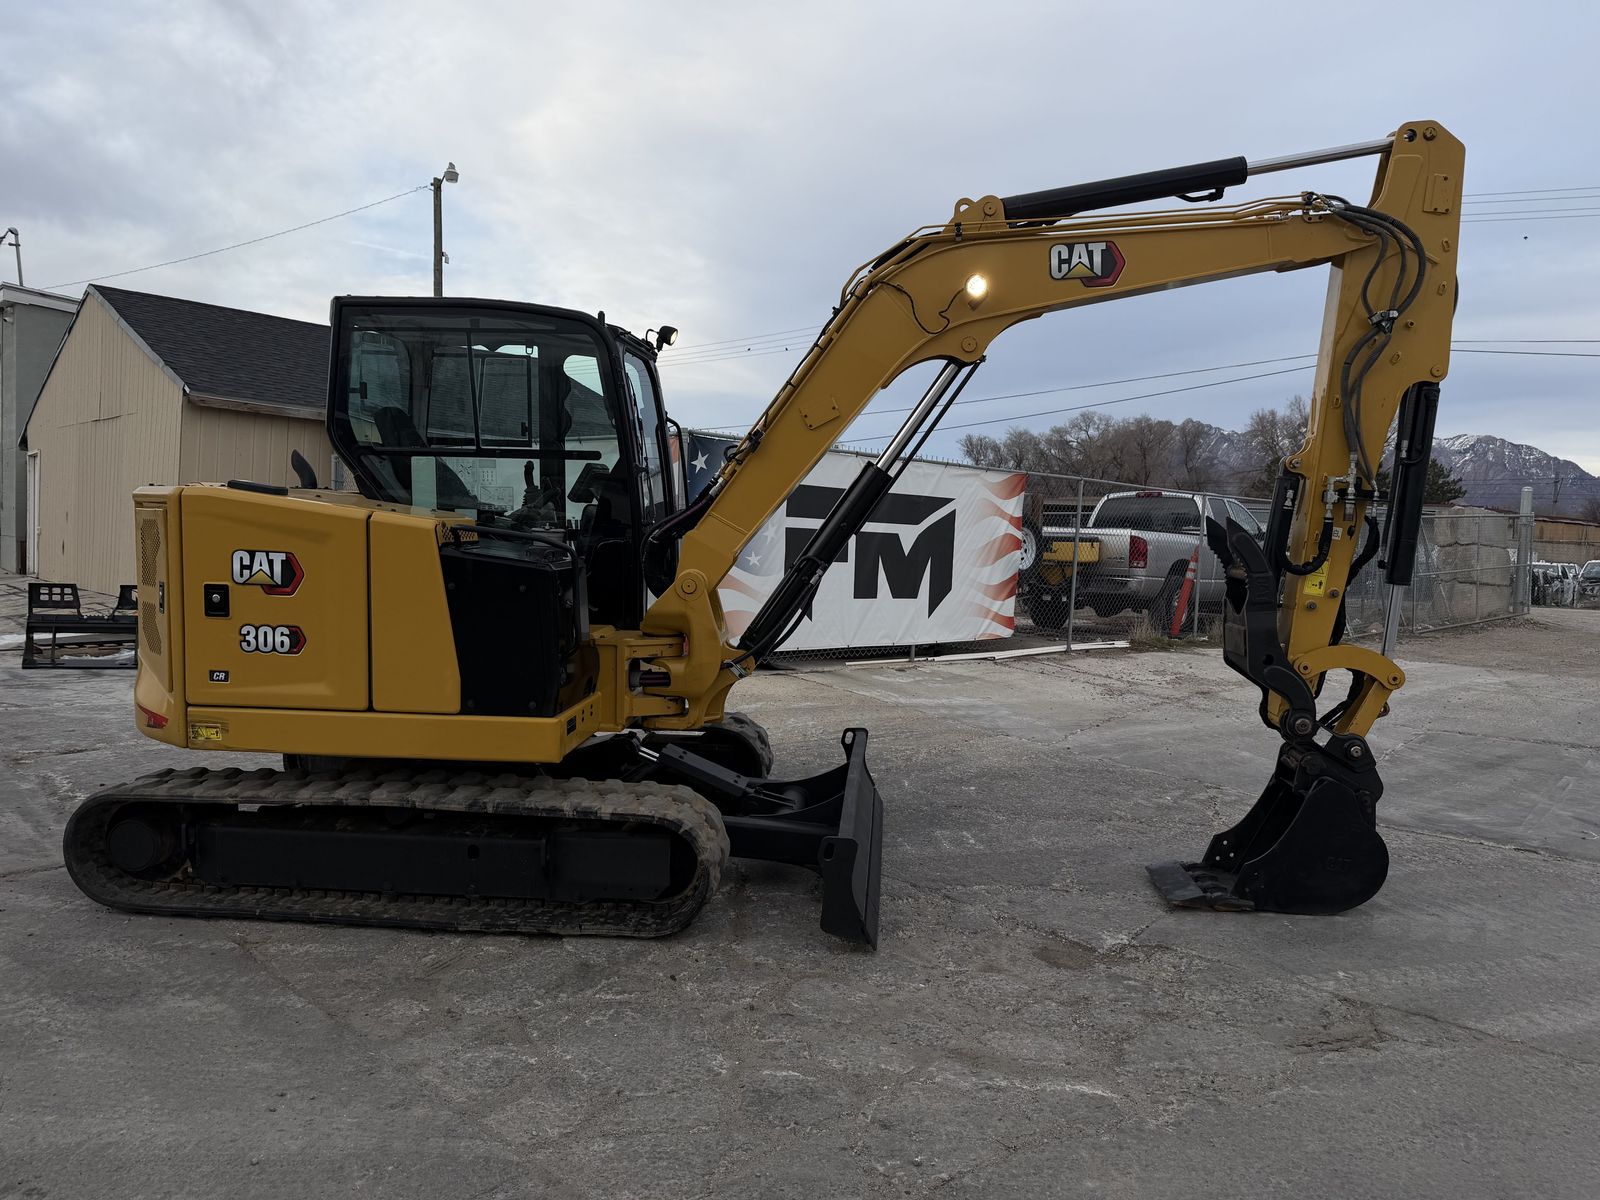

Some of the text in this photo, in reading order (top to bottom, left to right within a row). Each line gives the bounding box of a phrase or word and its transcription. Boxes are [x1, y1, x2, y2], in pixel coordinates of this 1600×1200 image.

[1050, 242, 1107, 280] CAT
[232, 550, 286, 585] CAT
[240, 625, 290, 653] 306
[213, 672, 226, 681] CR
